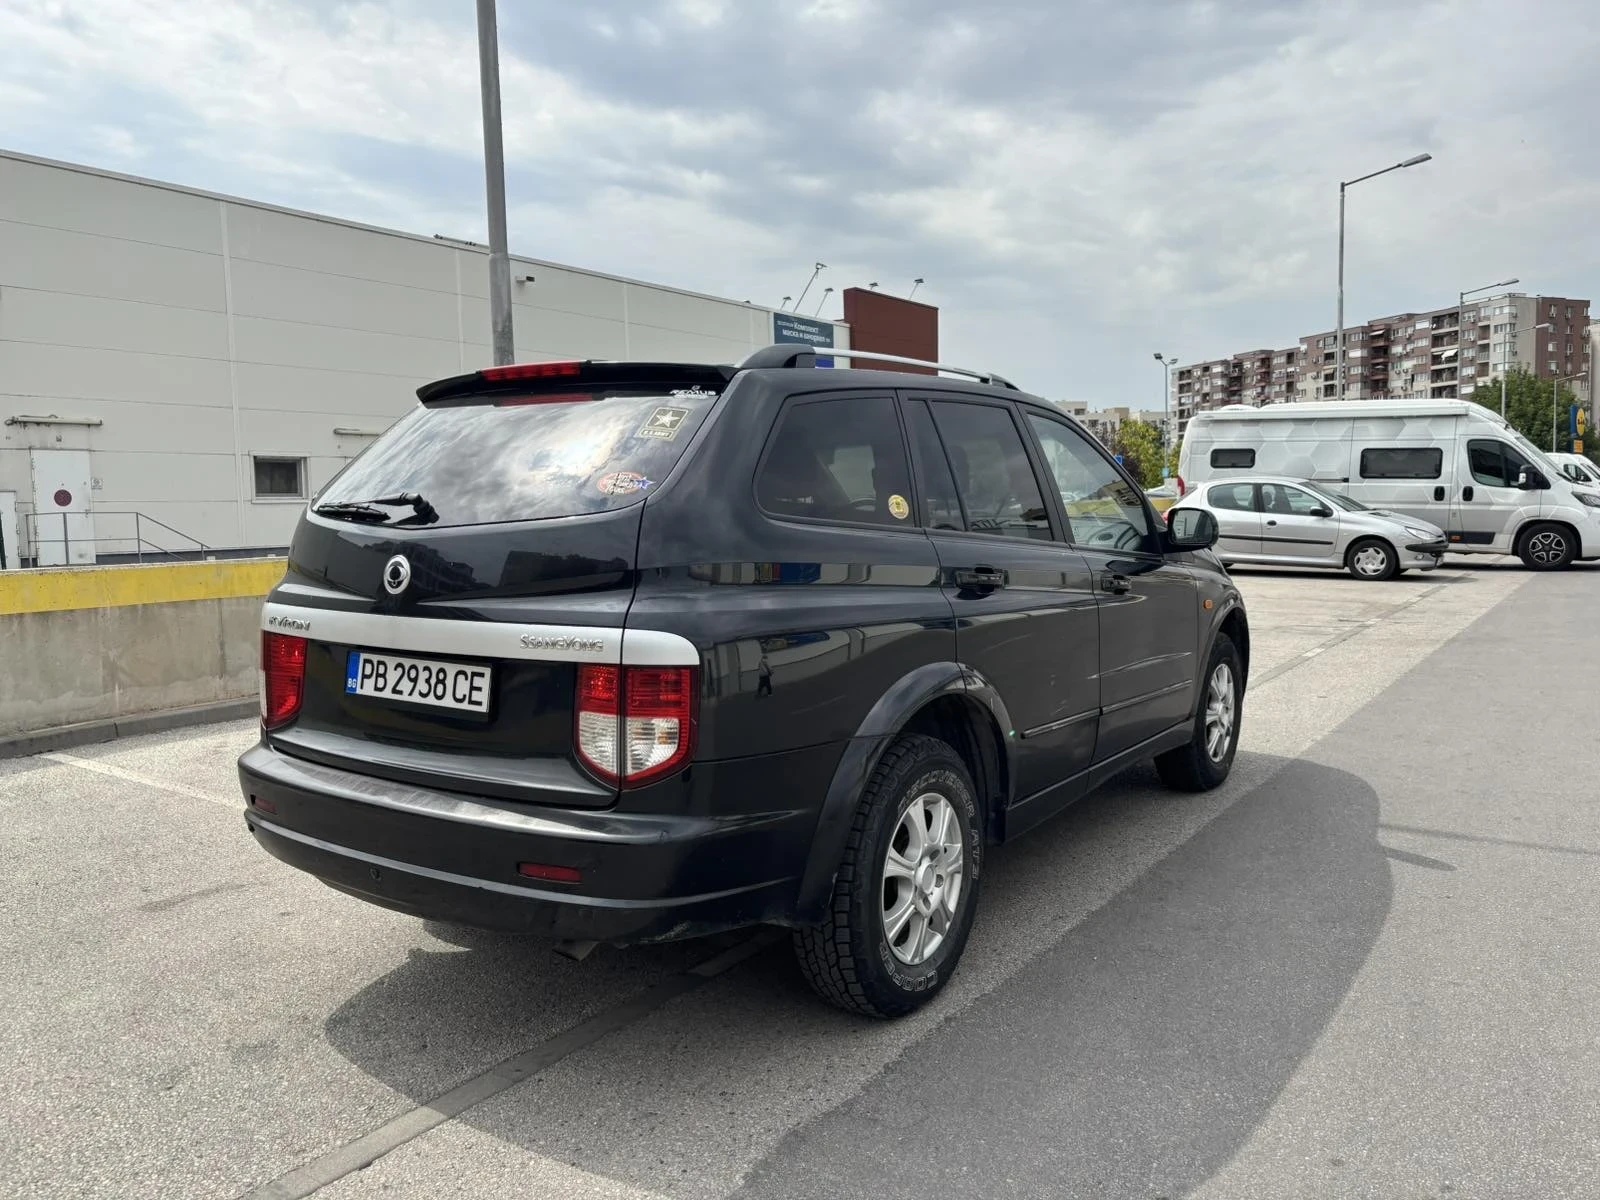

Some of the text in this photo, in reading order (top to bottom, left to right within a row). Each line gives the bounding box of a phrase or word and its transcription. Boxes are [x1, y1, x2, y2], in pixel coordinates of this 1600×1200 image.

[347, 658, 485, 706] BG PB 2938 CE
[879, 939, 938, 992] COOPER
